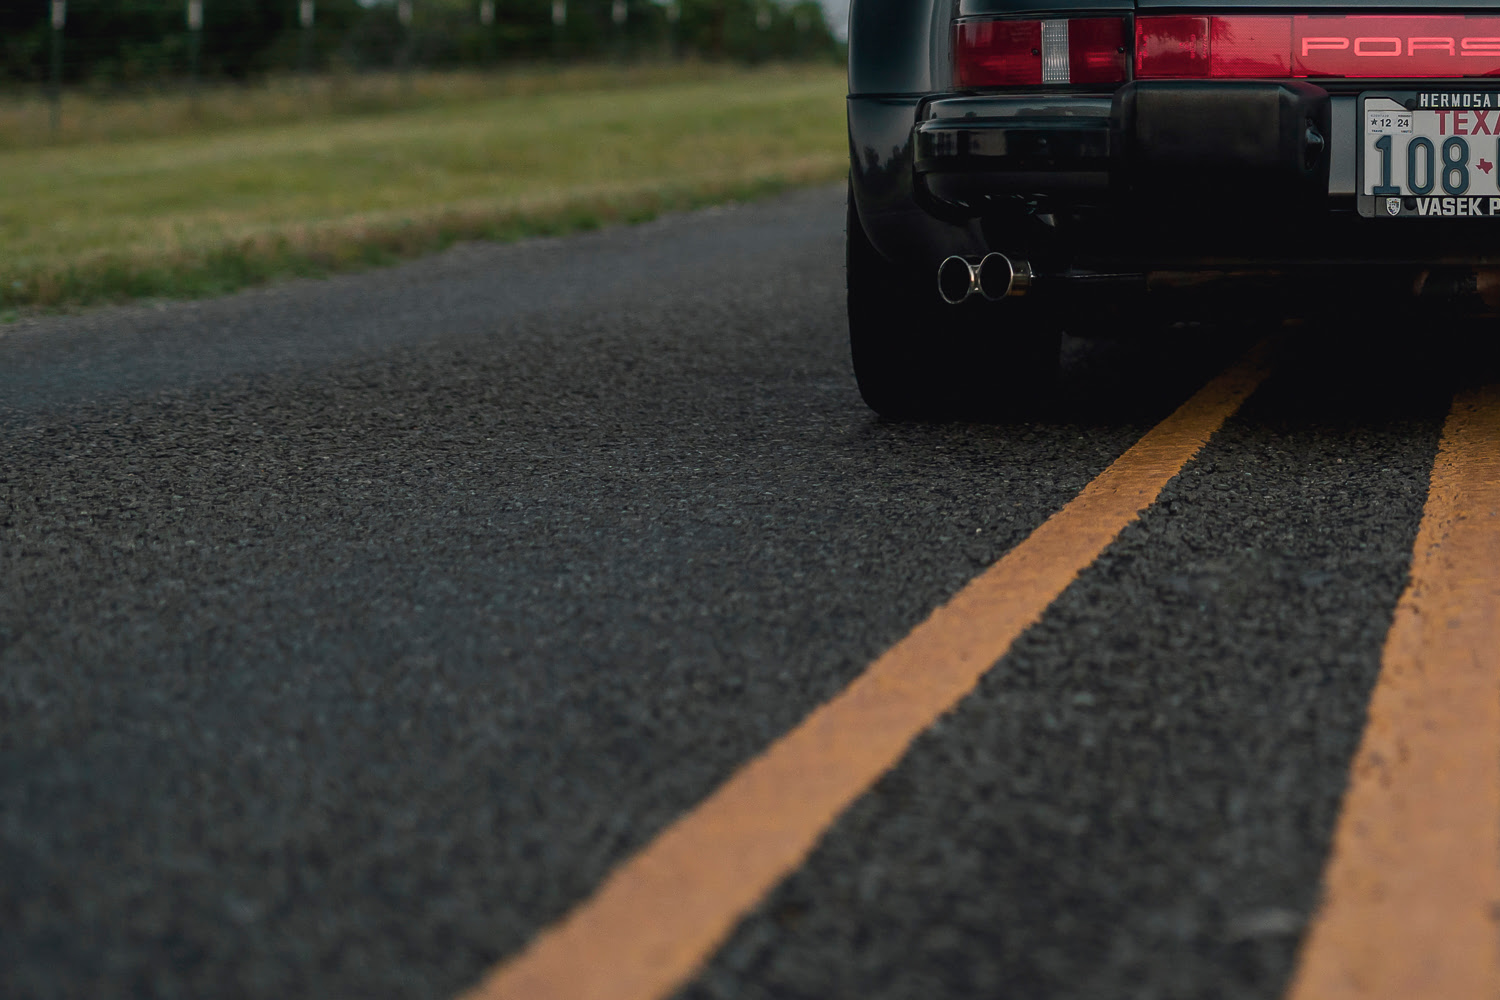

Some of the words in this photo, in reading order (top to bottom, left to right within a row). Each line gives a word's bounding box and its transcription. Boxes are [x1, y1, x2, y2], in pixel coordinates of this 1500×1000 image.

[1420, 93, 1491, 108] HERMOSA
[1380, 118, 1392, 128] 12
[1397, 118, 1409, 128] 24
[1372, 135, 1470, 195] 108
[1415, 197, 1483, 216] VASEK
